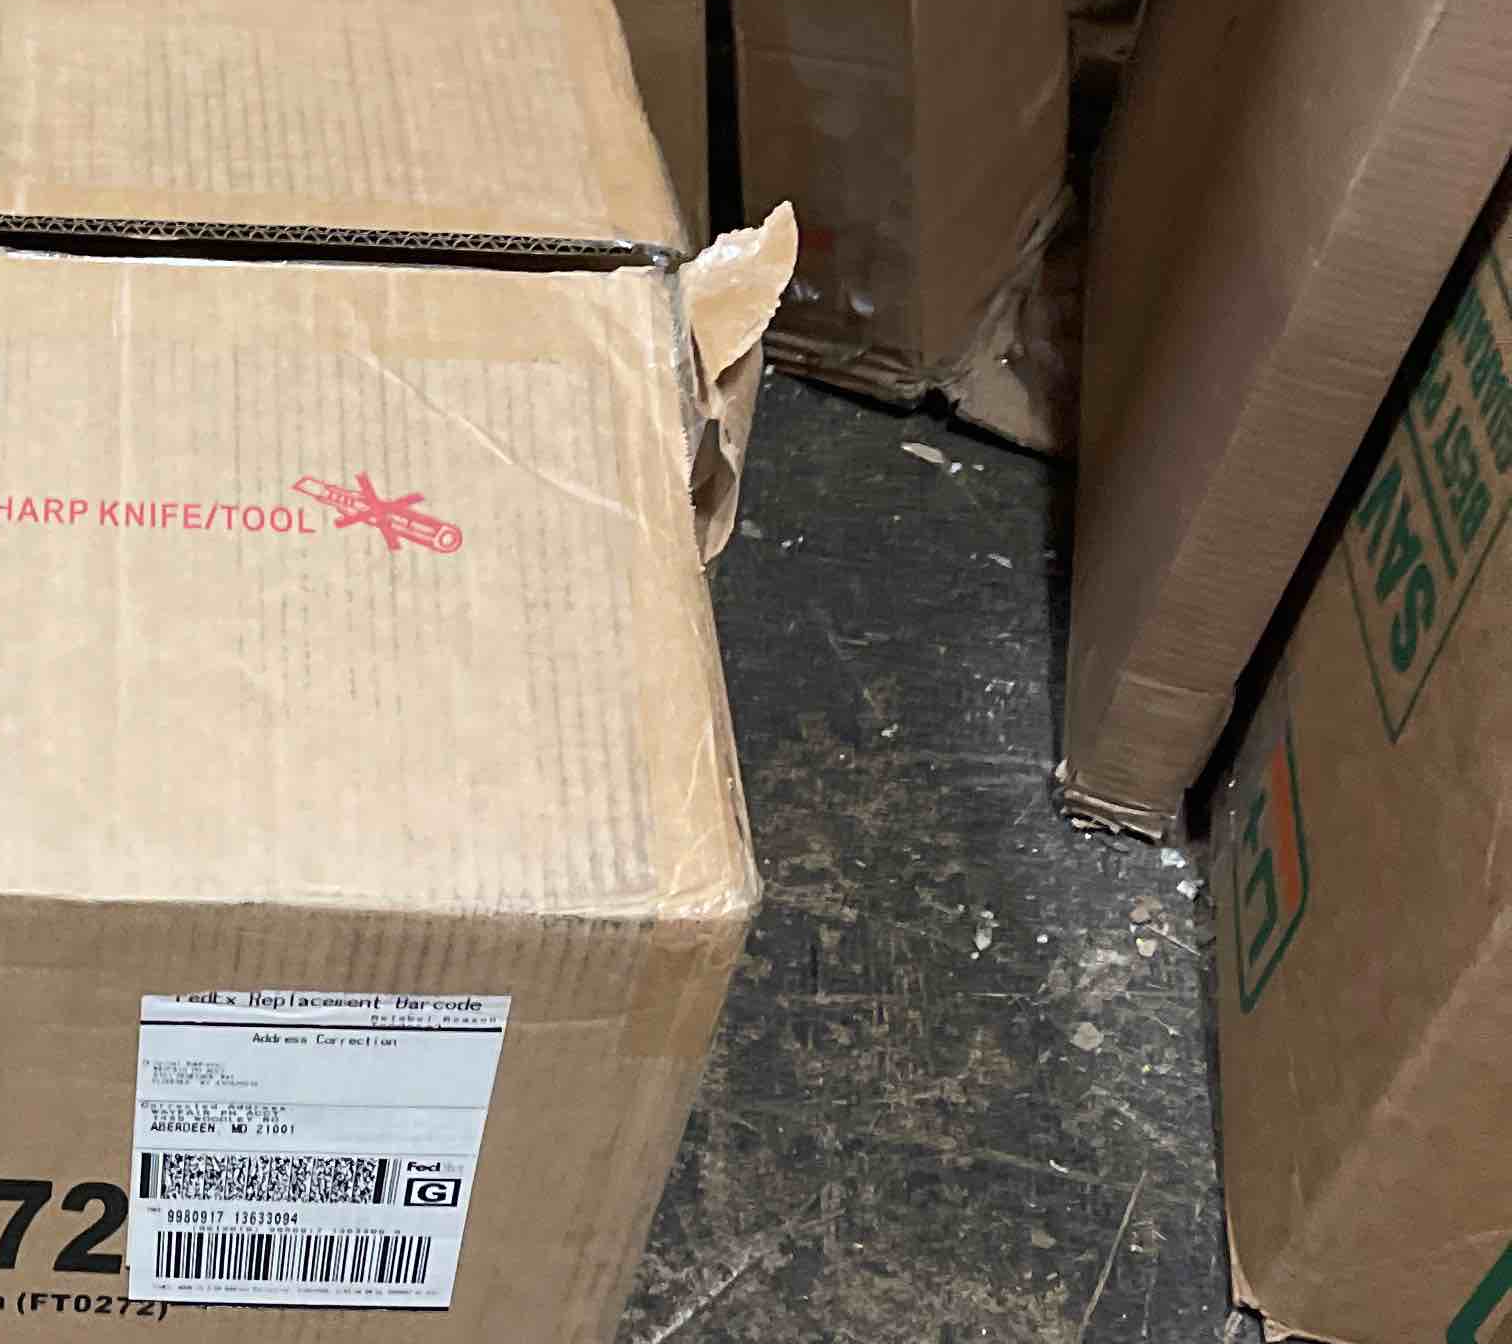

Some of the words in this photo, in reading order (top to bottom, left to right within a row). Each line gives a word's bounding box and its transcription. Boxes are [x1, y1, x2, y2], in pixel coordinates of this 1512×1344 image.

[99, 500, 317, 534] KNIFE/TOOL
[249, 991, 382, 1010] Replacement
[395, 996, 484, 1012] Barcode
[252, 1032, 308, 1045] Address
[316, 1033, 398, 1048] Correction
[231, 1123, 248, 1134] MD
[256, 1124, 295, 1135] 21001
[416, 1182, 448, 1203] G
[234, 1211, 299, 1226] 13633094
